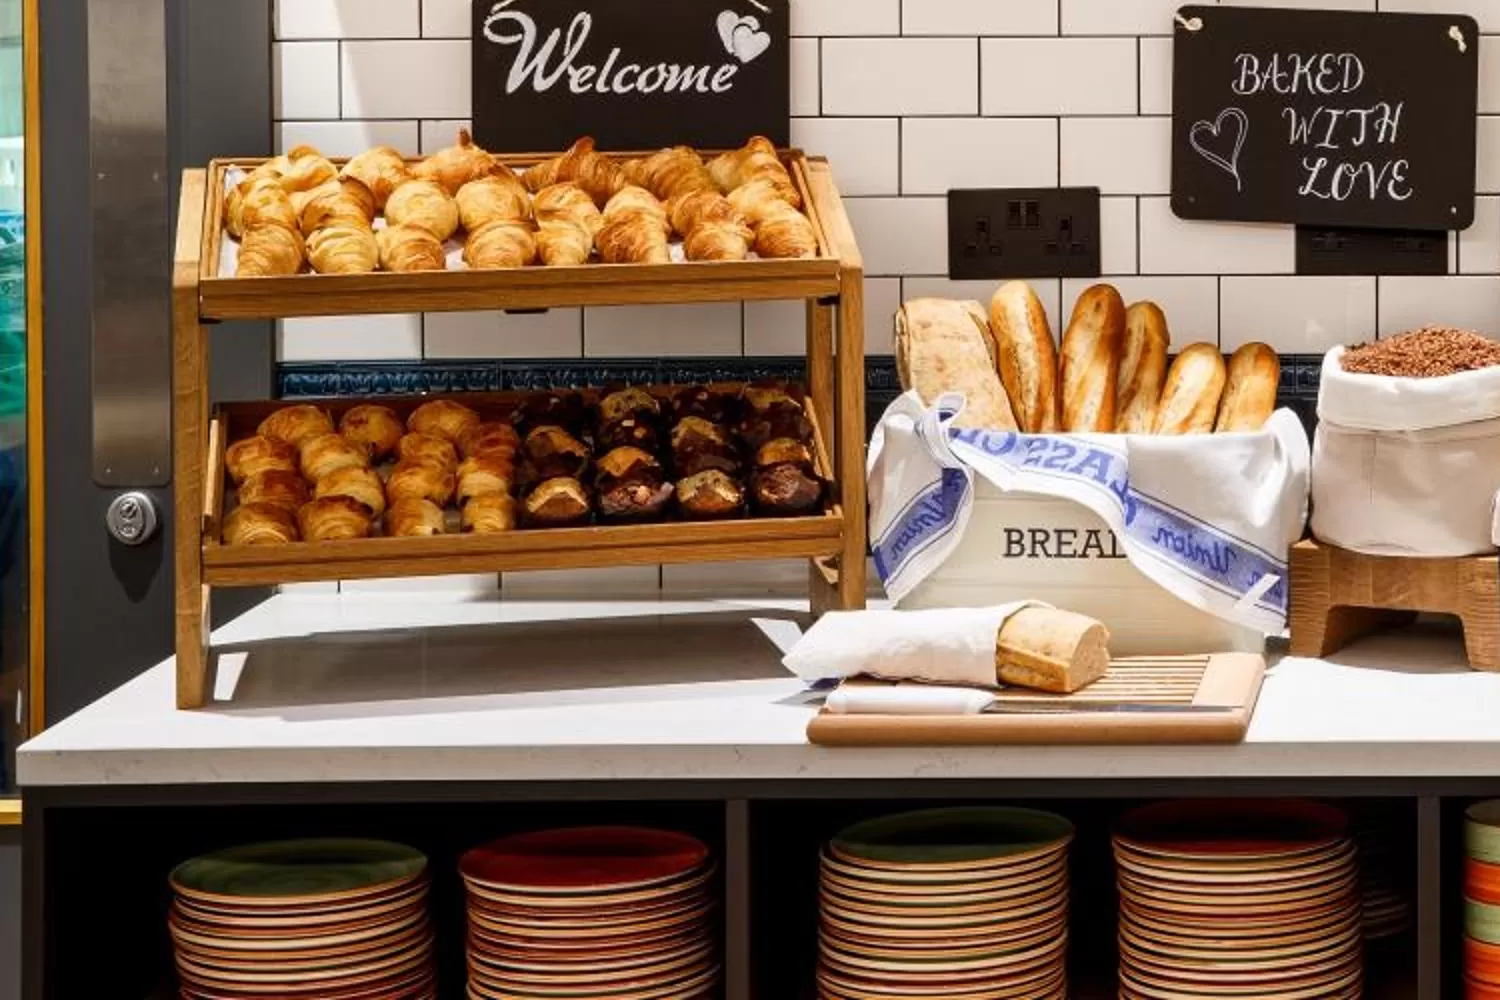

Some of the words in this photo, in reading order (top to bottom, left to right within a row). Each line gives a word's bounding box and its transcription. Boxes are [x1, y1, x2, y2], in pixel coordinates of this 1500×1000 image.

[483, 10, 738, 94] Welcome
[1231, 52, 1365, 95] BAKED
[1281, 101, 1405, 149] WITH
[1298, 156, 1413, 200] LOVE
